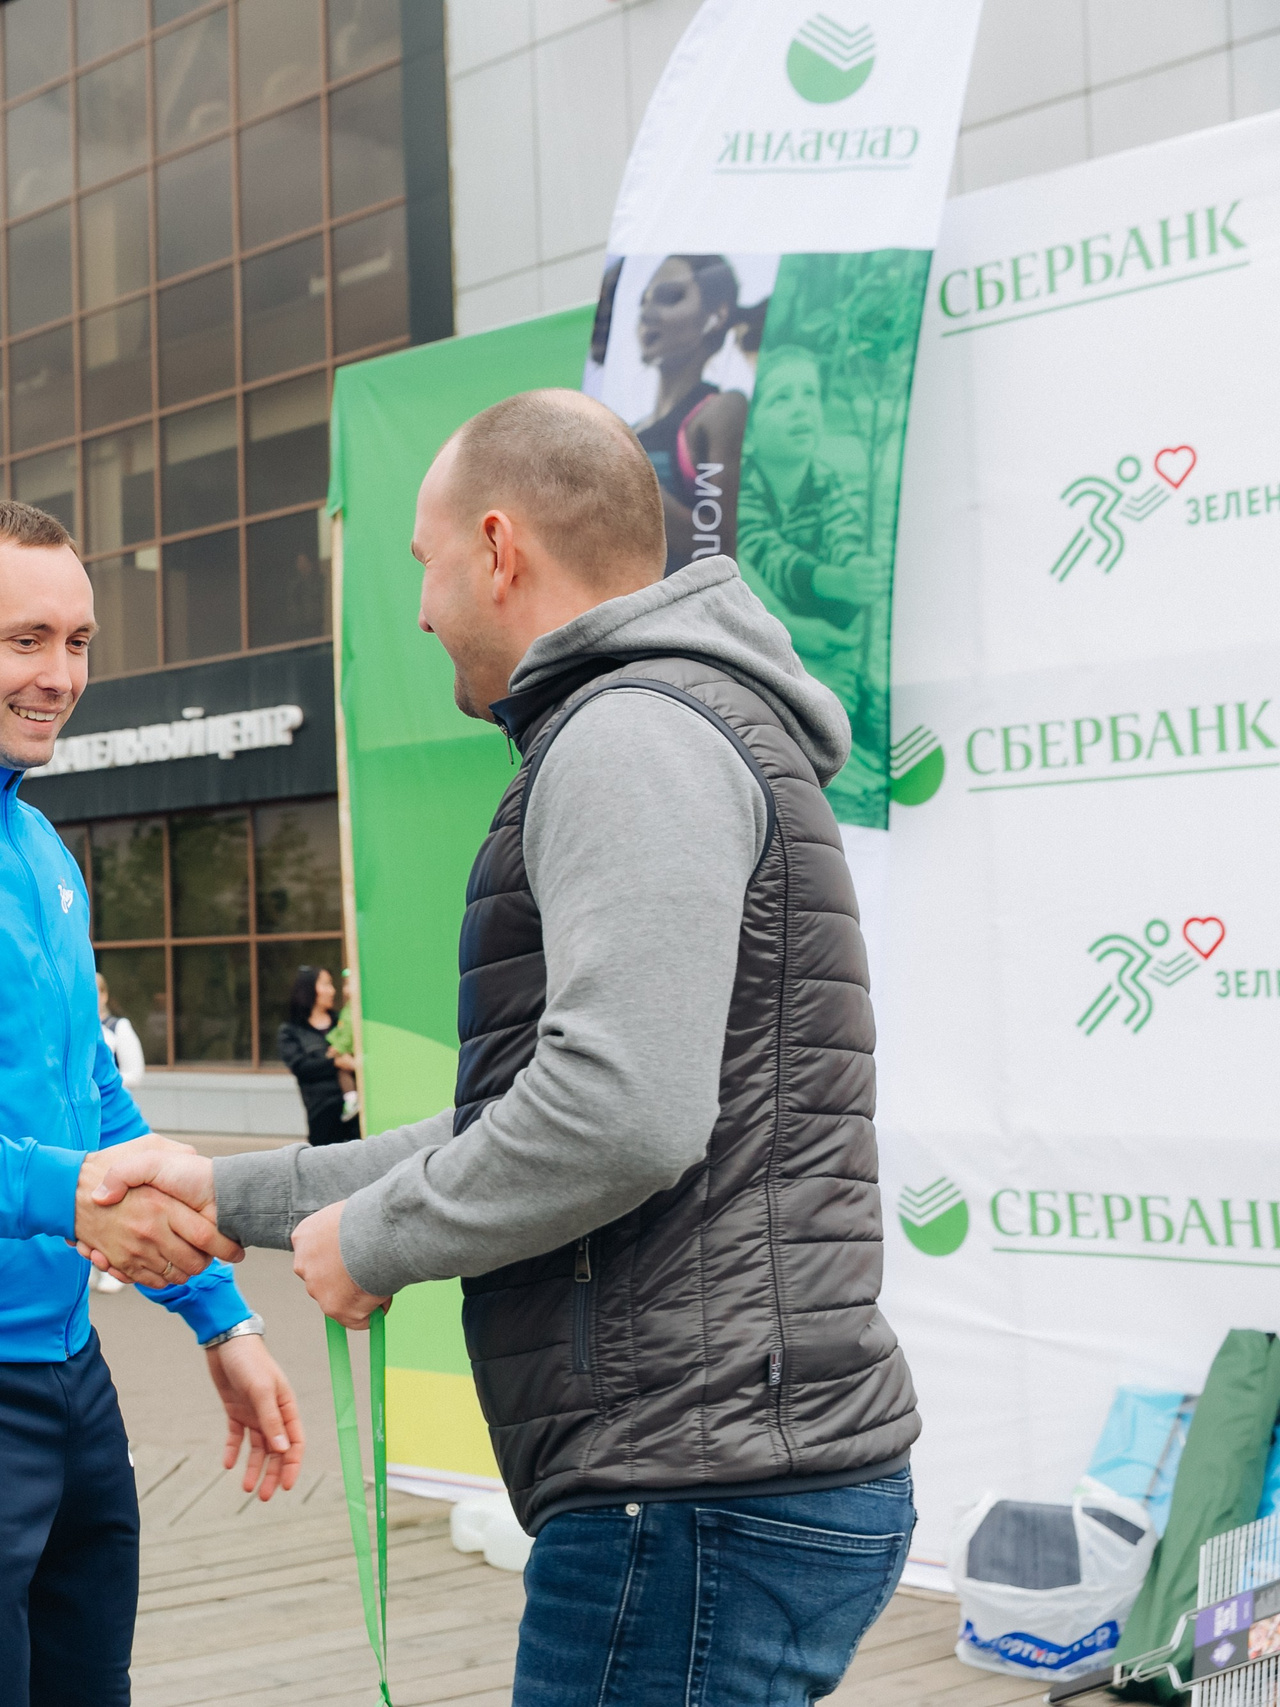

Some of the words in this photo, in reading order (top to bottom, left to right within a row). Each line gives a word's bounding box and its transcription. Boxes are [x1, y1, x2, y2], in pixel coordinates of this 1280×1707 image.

[938, 200, 1249, 320] СБЕРБАНК
[965, 699, 1279, 776] СБЕРБАНК
[1215, 968, 1280, 998] ЗЕЛ
